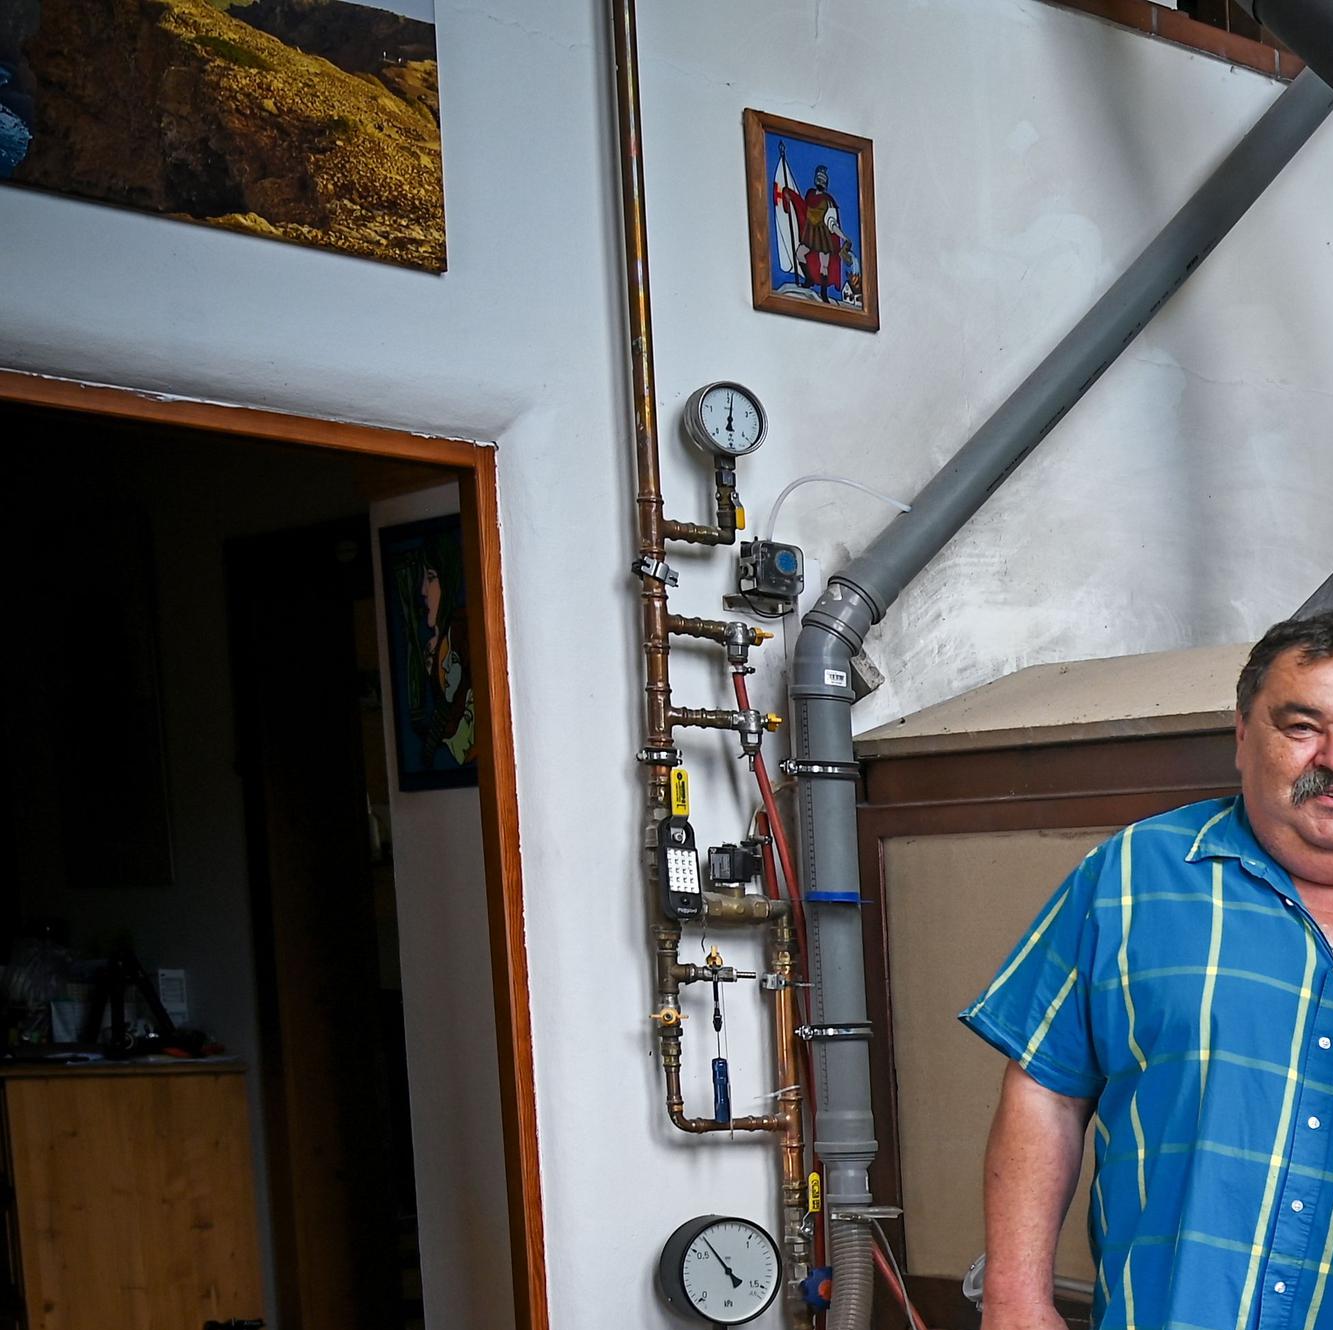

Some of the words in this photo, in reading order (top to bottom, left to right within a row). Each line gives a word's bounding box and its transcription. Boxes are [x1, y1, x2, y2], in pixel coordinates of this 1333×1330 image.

[696, 1250, 710, 1260] 0.5
[749, 1279, 760, 1288] 1.5
[702, 1291, 708, 1299] 0
